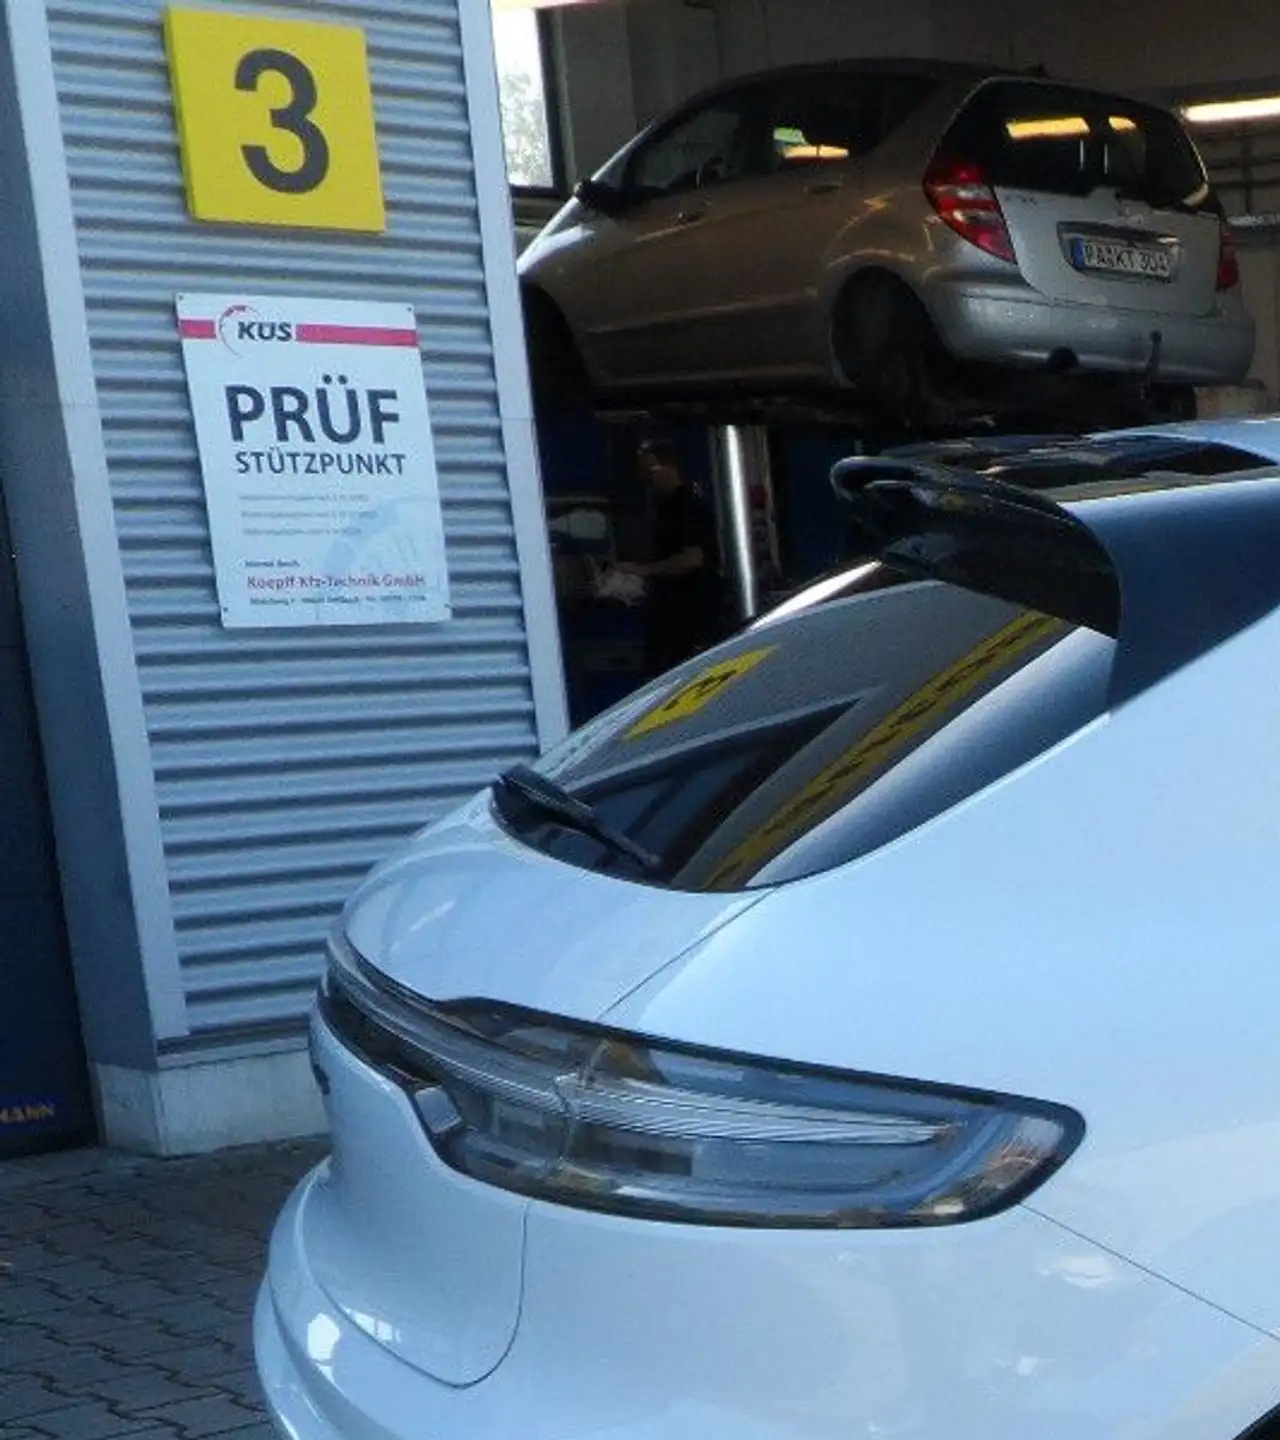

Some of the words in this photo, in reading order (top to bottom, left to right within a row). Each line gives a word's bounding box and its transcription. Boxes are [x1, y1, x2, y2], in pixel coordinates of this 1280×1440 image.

[233, 46, 330, 194] 3
[224, 373, 400, 445] PRÜF
[235, 446, 407, 475] STÜTZPUNKT
[382, 573, 426, 588] GmbH
